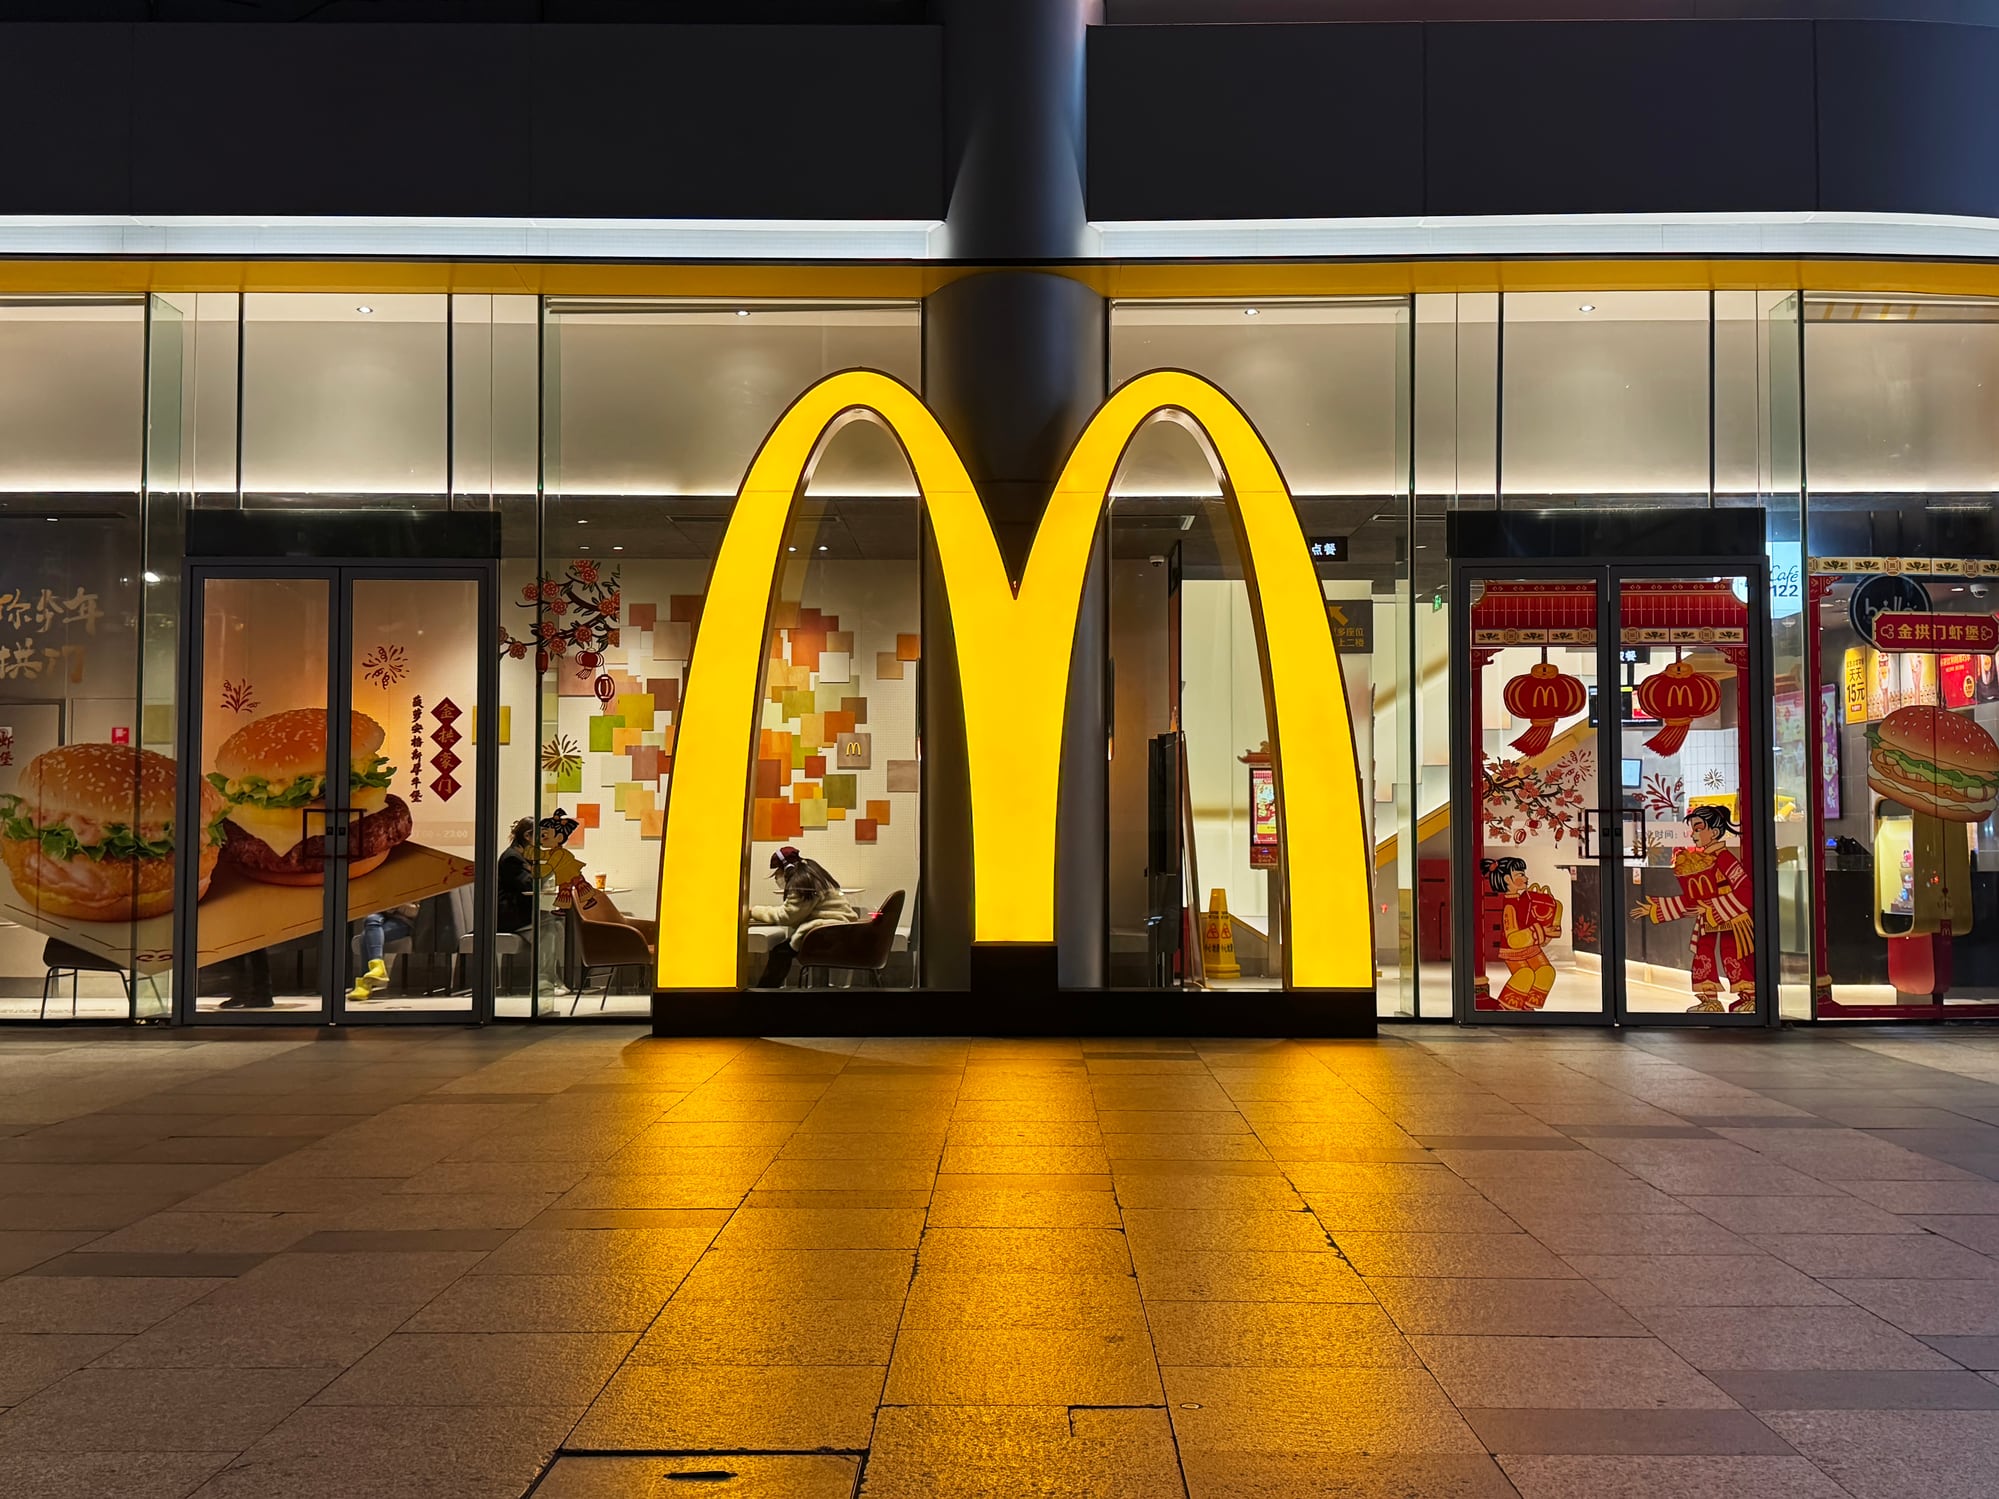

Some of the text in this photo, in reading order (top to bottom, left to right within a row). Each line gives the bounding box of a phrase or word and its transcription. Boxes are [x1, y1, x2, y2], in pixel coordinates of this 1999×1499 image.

[1311, 543, 1337, 556] 点餐
[1897, 623, 1980, 641] 金拱门虾堡
[1847, 682, 1865, 703] 15元
[437, 703, 455, 793] 金拱豪门
